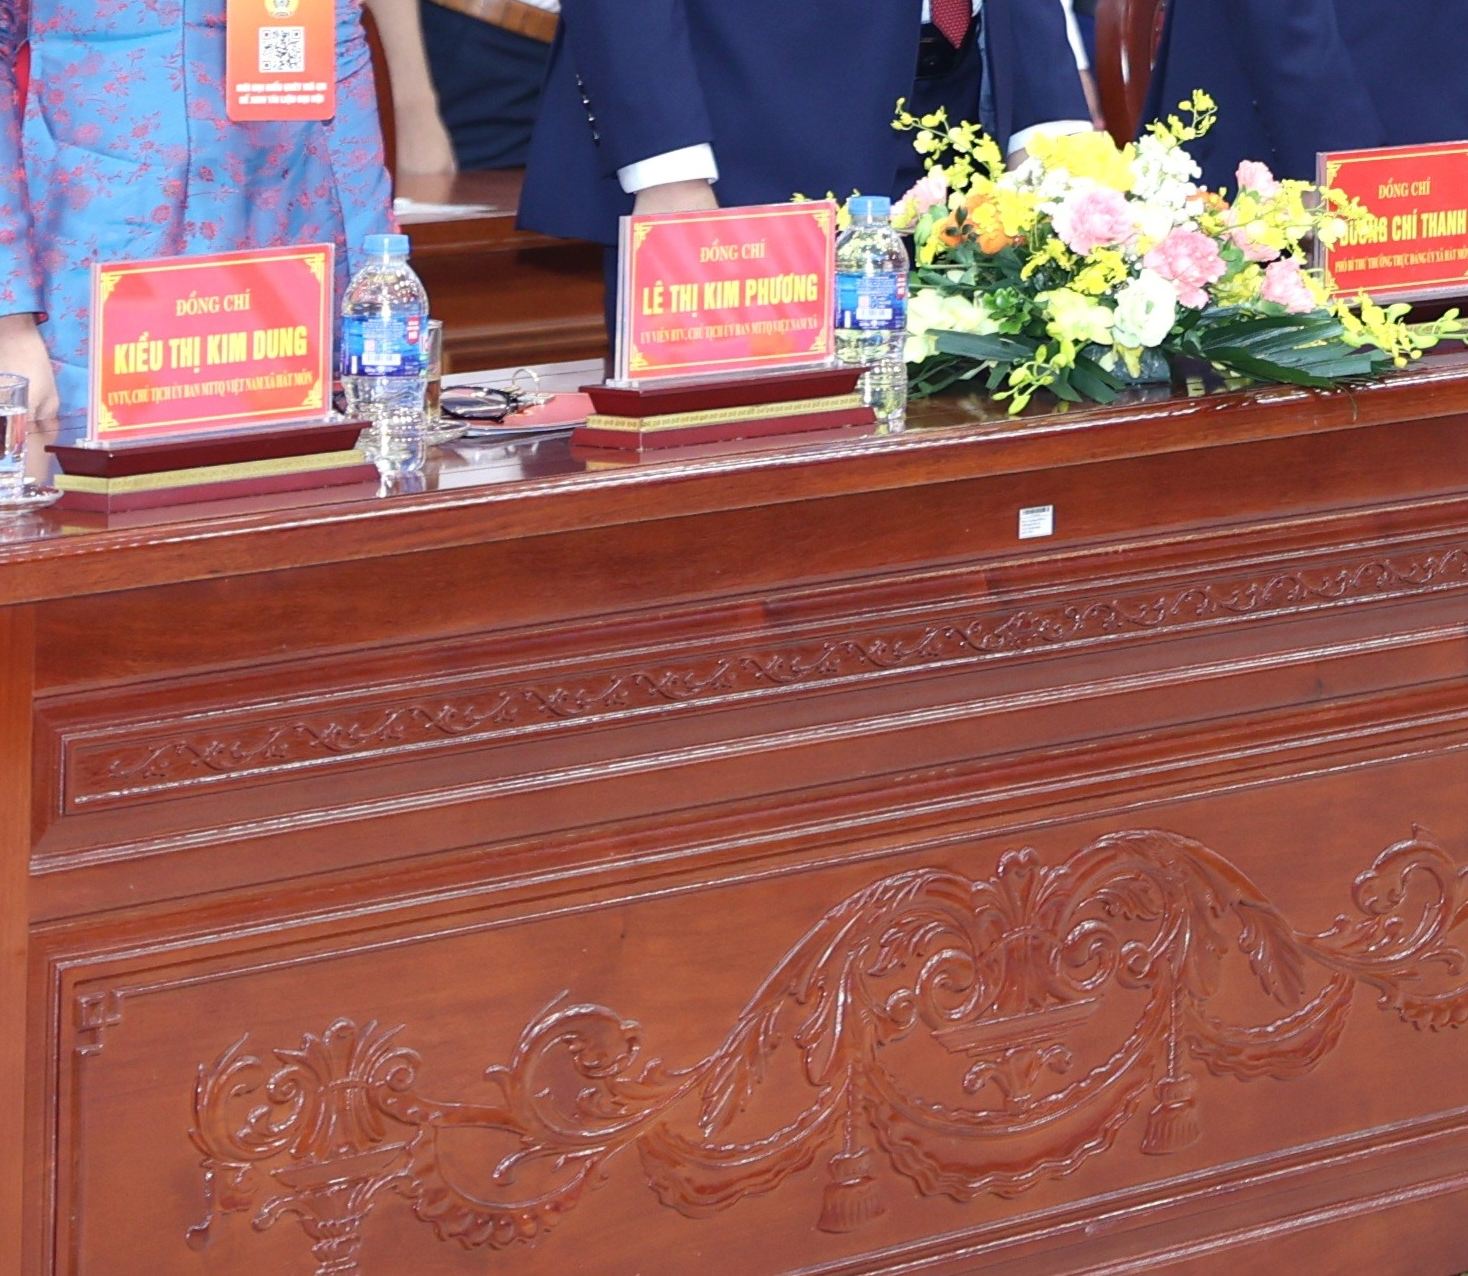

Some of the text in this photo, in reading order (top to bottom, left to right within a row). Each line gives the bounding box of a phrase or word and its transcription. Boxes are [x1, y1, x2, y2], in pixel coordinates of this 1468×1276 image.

[1411, 176, 1431, 196] CHÍ
[1391, 209, 1418, 242] CHÍ
[1420, 209, 1468, 239] THANH
[700, 239, 765, 263] ĐỒNG CHÍ
[175, 288, 251, 317] ĐỒNG CHÍ
[642, 280, 664, 315] LÊ
[669, 283, 698, 317] THỊ
[703, 280, 740, 310] KIM
[745, 273, 818, 307] PHƯƠNG
[114, 325, 308, 375] KIỀU THỊ KIM DUNG
